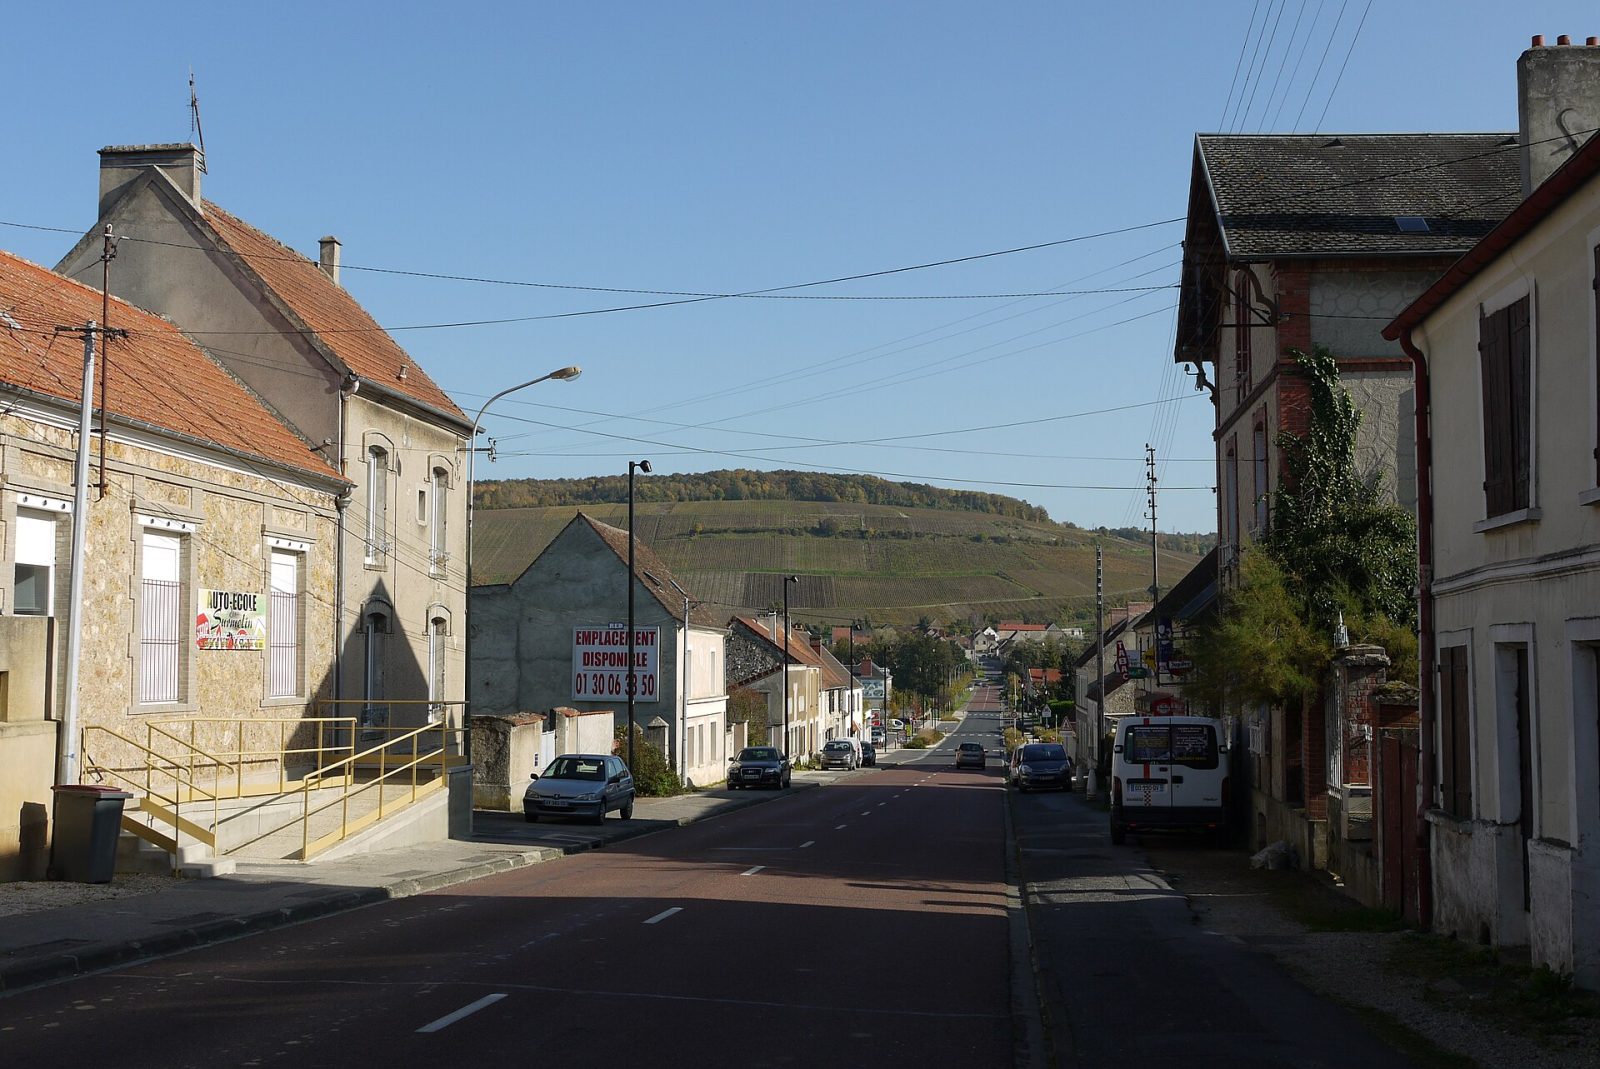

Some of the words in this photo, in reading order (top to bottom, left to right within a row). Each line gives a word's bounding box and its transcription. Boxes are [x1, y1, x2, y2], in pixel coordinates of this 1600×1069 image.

[211, 608, 253, 630] Surmelin
[1117, 642, 1129, 680] TABAC
[576, 673, 587, 694] 01
[592, 673, 604, 695] 30
[608, 674, 621, 695] 06
[641, 674, 655, 695] 50
